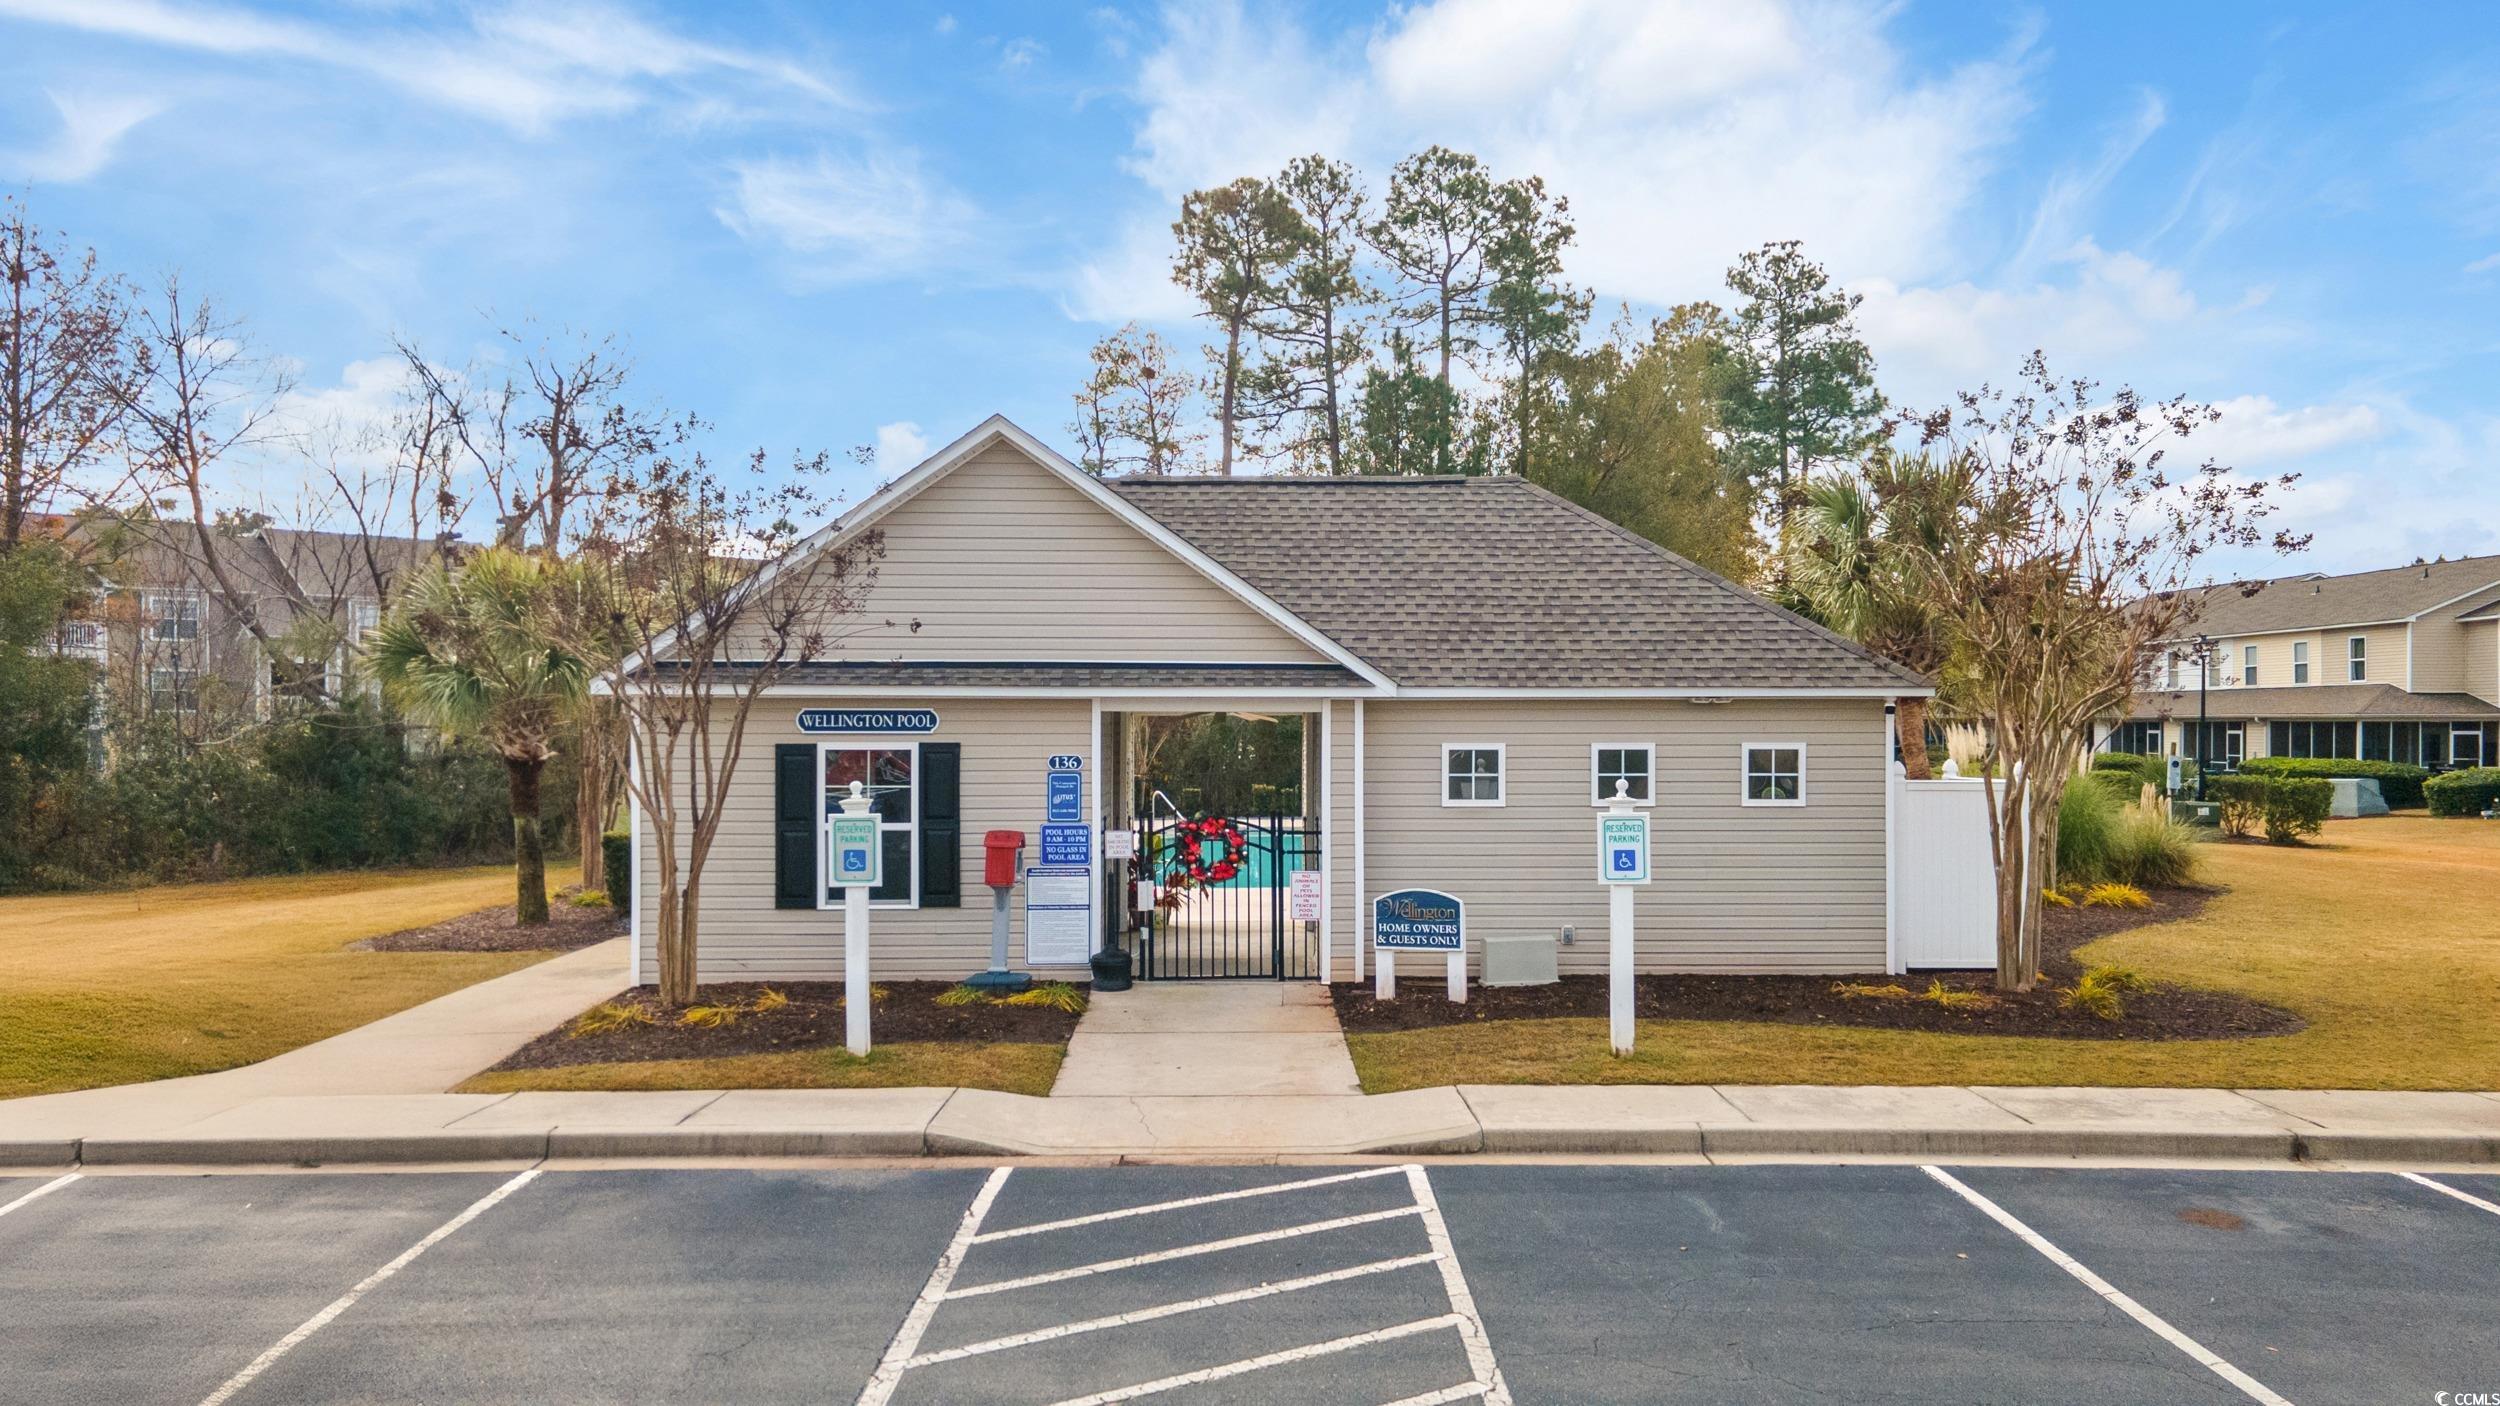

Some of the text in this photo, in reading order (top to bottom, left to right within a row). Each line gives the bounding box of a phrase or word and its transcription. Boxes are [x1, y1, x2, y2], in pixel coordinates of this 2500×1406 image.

[802, 714, 934, 728] WELLINGTON POOL
[1053, 756, 1078, 769] 136
[1609, 835, 1640, 843] PARKING
[1383, 897, 1455, 920] Wellington
[1379, 923, 1457, 934] HOME OWNERS
[1377, 934, 1458, 946] & GUESTS ONLY
